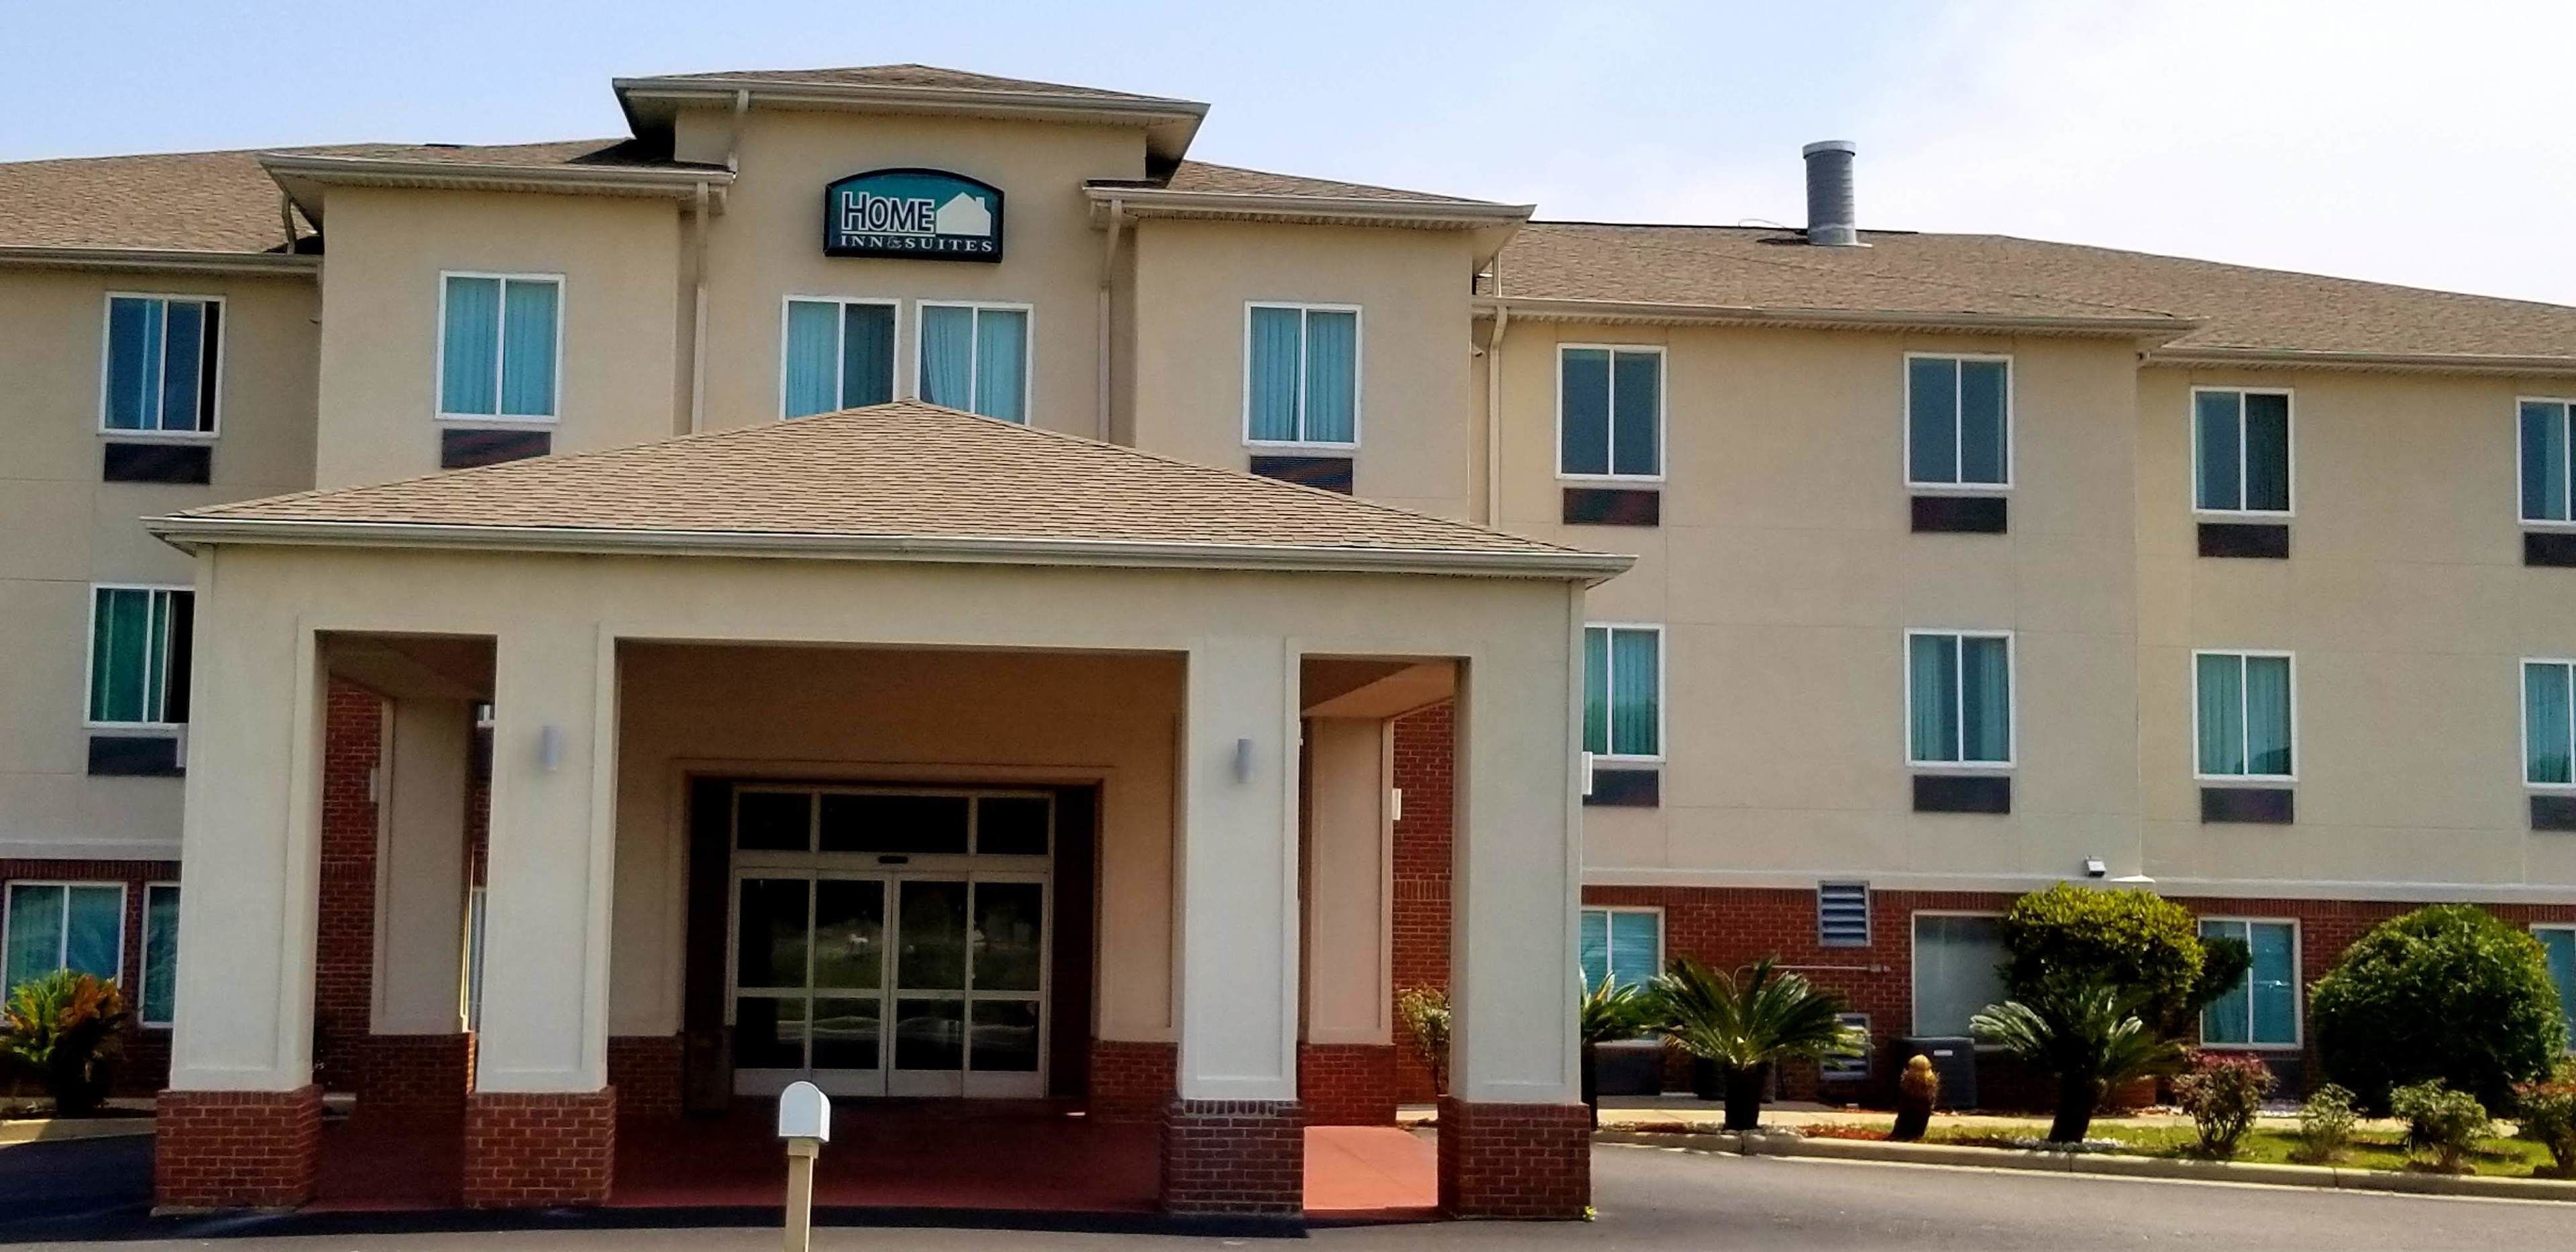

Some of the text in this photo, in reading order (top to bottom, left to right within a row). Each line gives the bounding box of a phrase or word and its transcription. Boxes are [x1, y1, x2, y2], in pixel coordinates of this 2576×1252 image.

[841, 191, 934, 233] HOME
[841, 235, 884, 247] INN
[905, 238, 993, 252] SUITES
